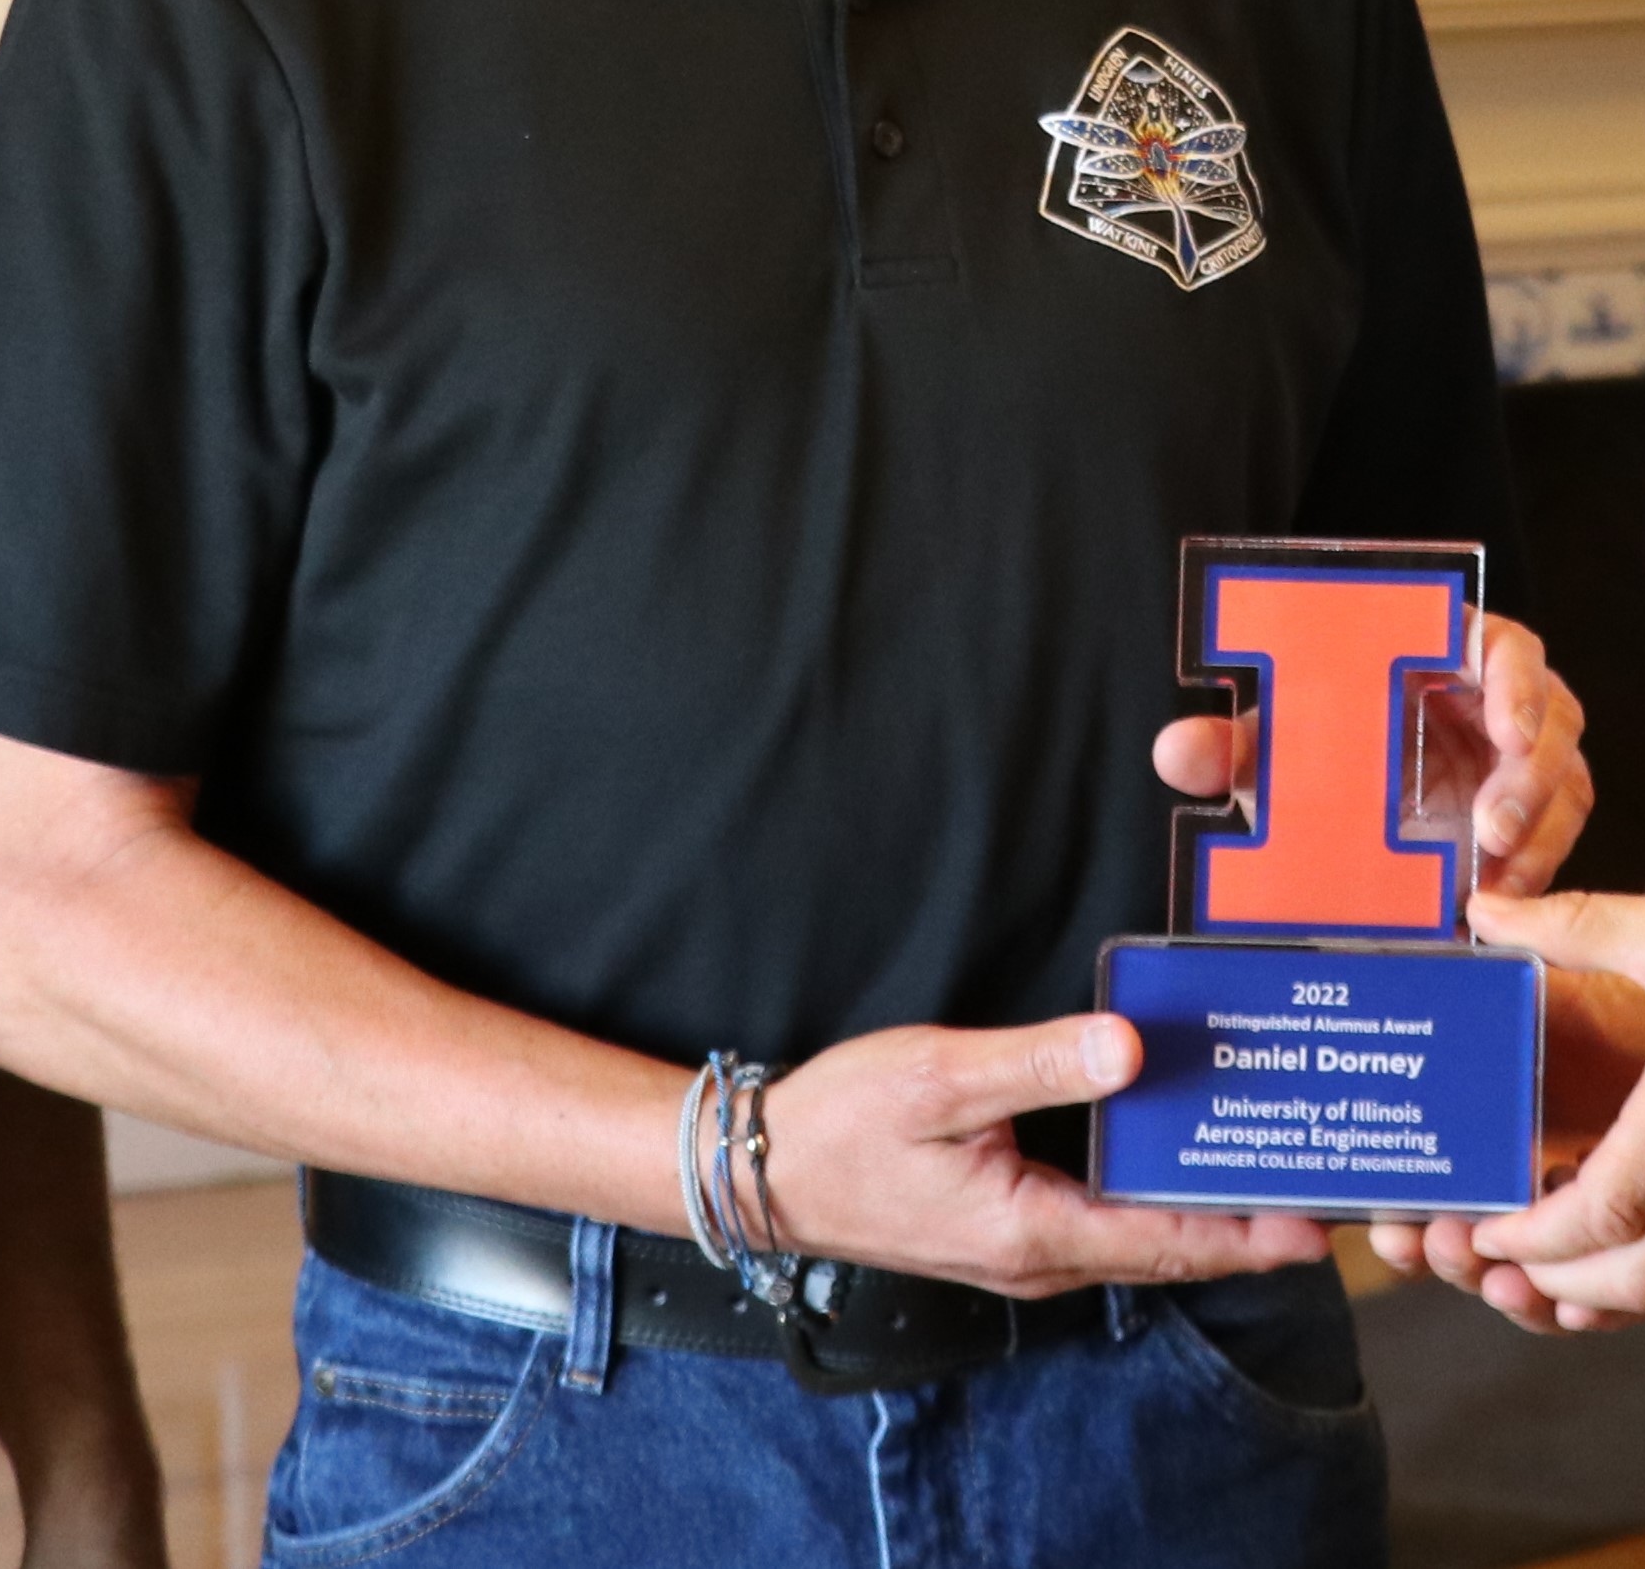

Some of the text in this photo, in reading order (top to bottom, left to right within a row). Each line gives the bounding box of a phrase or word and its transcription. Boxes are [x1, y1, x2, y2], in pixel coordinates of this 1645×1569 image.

[1163, 55, 1212, 100] HINES
[1087, 215, 1159, 258] WATKINS
[1291, 981, 1350, 1007] 2022
[1207, 1012, 1433, 1037] Distinguished Alumnus Award
[1213, 1043, 1425, 1080] Daniel Dorney
[1212, 1095, 1423, 1125] University of Illinois
[1194, 1121, 1438, 1155] Aerospace Engineering
[1178, 1149, 1452, 1175] GRAINGER COLLEGE OF ENGINEERING
